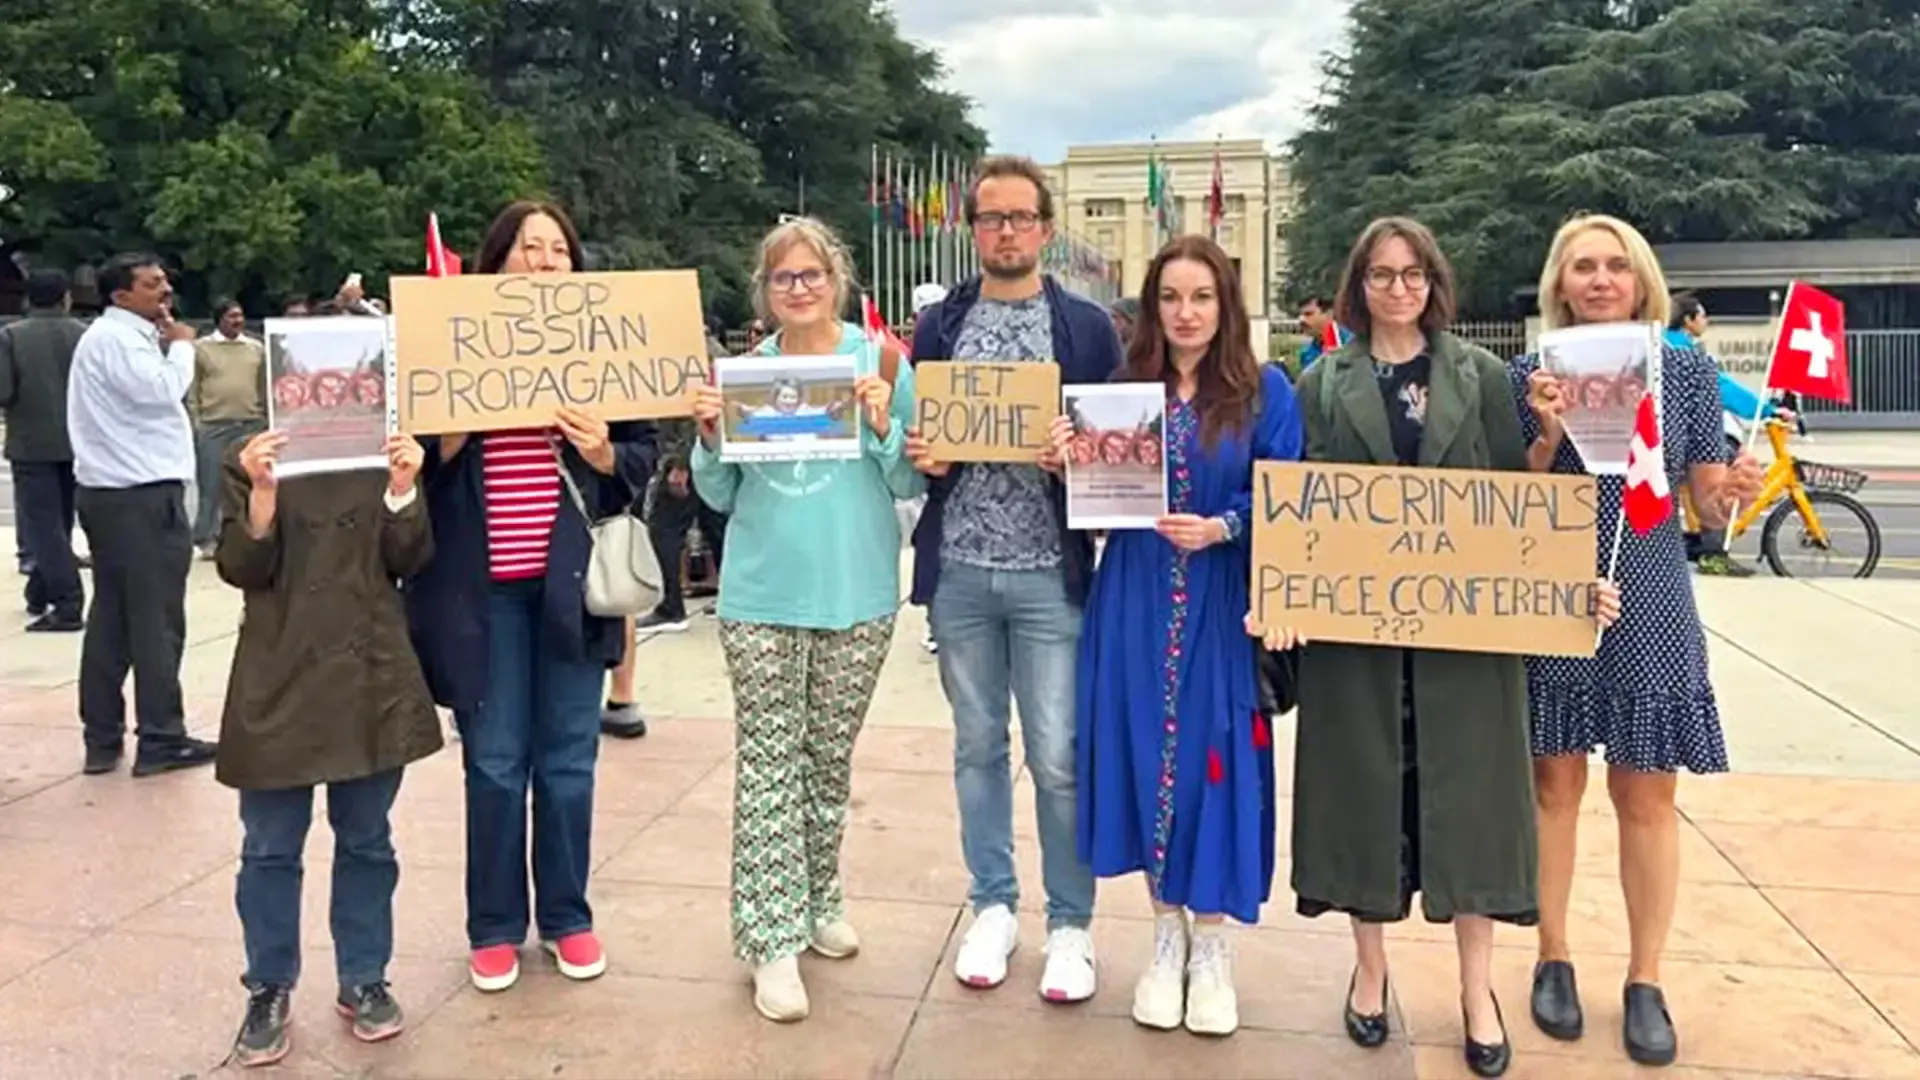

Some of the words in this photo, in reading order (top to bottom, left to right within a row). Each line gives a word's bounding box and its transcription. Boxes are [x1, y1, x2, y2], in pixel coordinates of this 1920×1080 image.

[492, 276, 611, 318] STOP
[449, 313, 648, 362] RUSSIAN
[407, 355, 708, 420] PROPAGANDA
[950, 366, 1015, 398] НЕТ
[919, 397, 1043, 449] ВОЙНЕ
[1434, 532, 1456, 554] A
[1258, 564, 1383, 622] PEACE
[1389, 574, 1597, 618] CONFERENCE
[1372, 617, 1425, 640] ???
